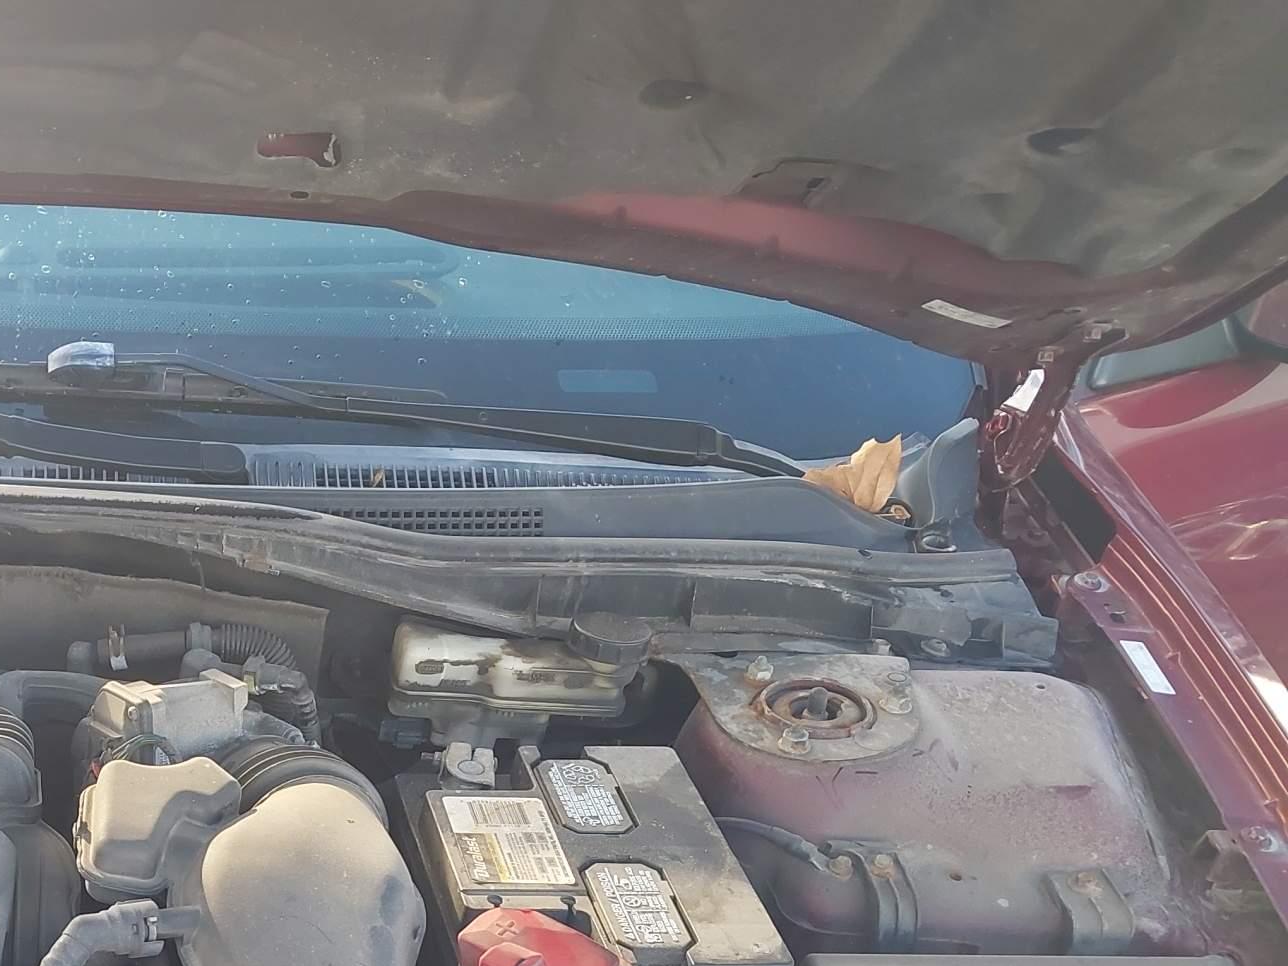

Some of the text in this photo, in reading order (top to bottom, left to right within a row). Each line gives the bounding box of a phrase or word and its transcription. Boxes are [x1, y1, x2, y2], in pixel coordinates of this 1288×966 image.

[462, 837, 490, 879] Duralast
[596, 872, 616, 898] POISON
[610, 903, 634, 933] DANGER
